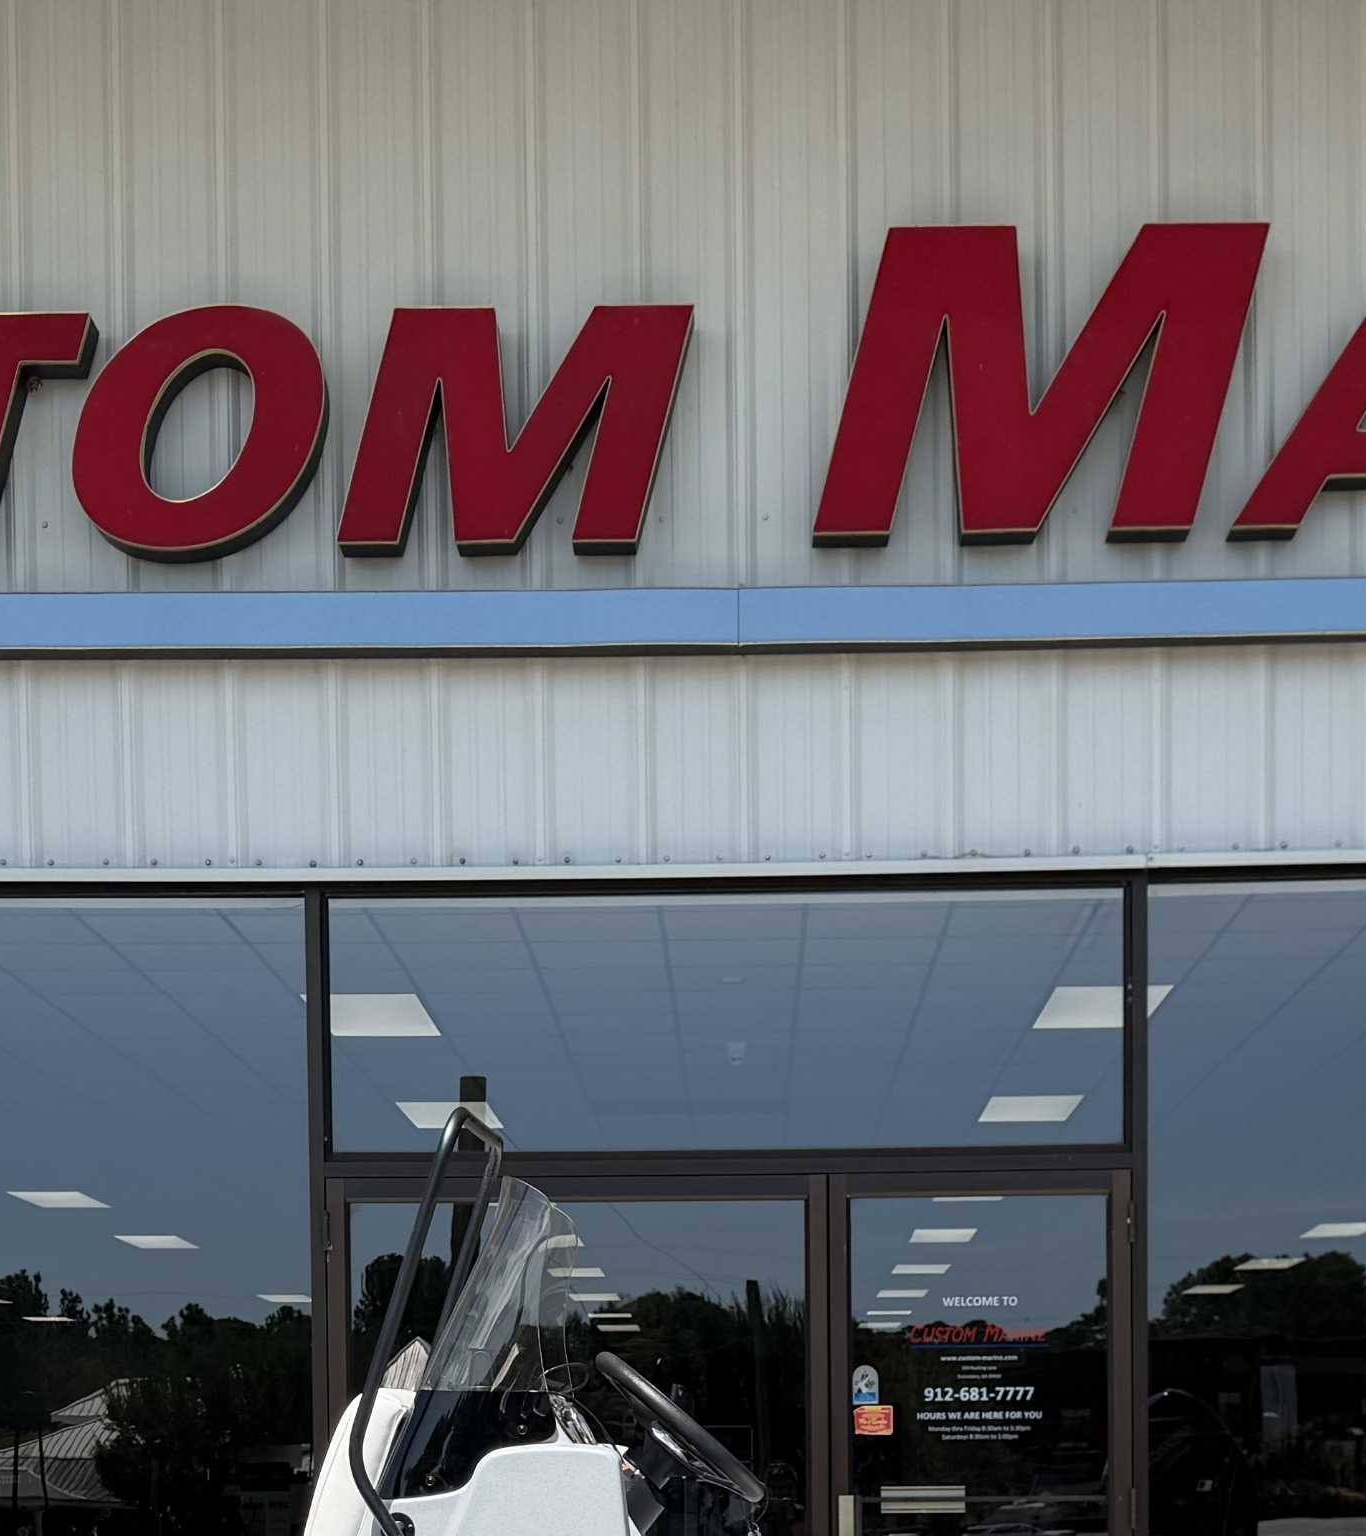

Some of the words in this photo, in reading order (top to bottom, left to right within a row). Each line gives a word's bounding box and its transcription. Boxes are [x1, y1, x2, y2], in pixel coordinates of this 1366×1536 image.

[942, 1296, 999, 1307] WELCOME
[1003, 1296, 1018, 1306] TO
[909, 1326, 977, 1343] CUSTOM
[923, 1386, 1035, 1401] 912-681-7777
[916, 1411, 947, 1420] HOURS
[947, 1411, 961, 1420] WE
[963, 1411, 980, 1419] ARE
[981, 1411, 1004, 1419] HERE
[1005, 1411, 1023, 1419] FOR
[1024, 1410, 1043, 1419] YOU
